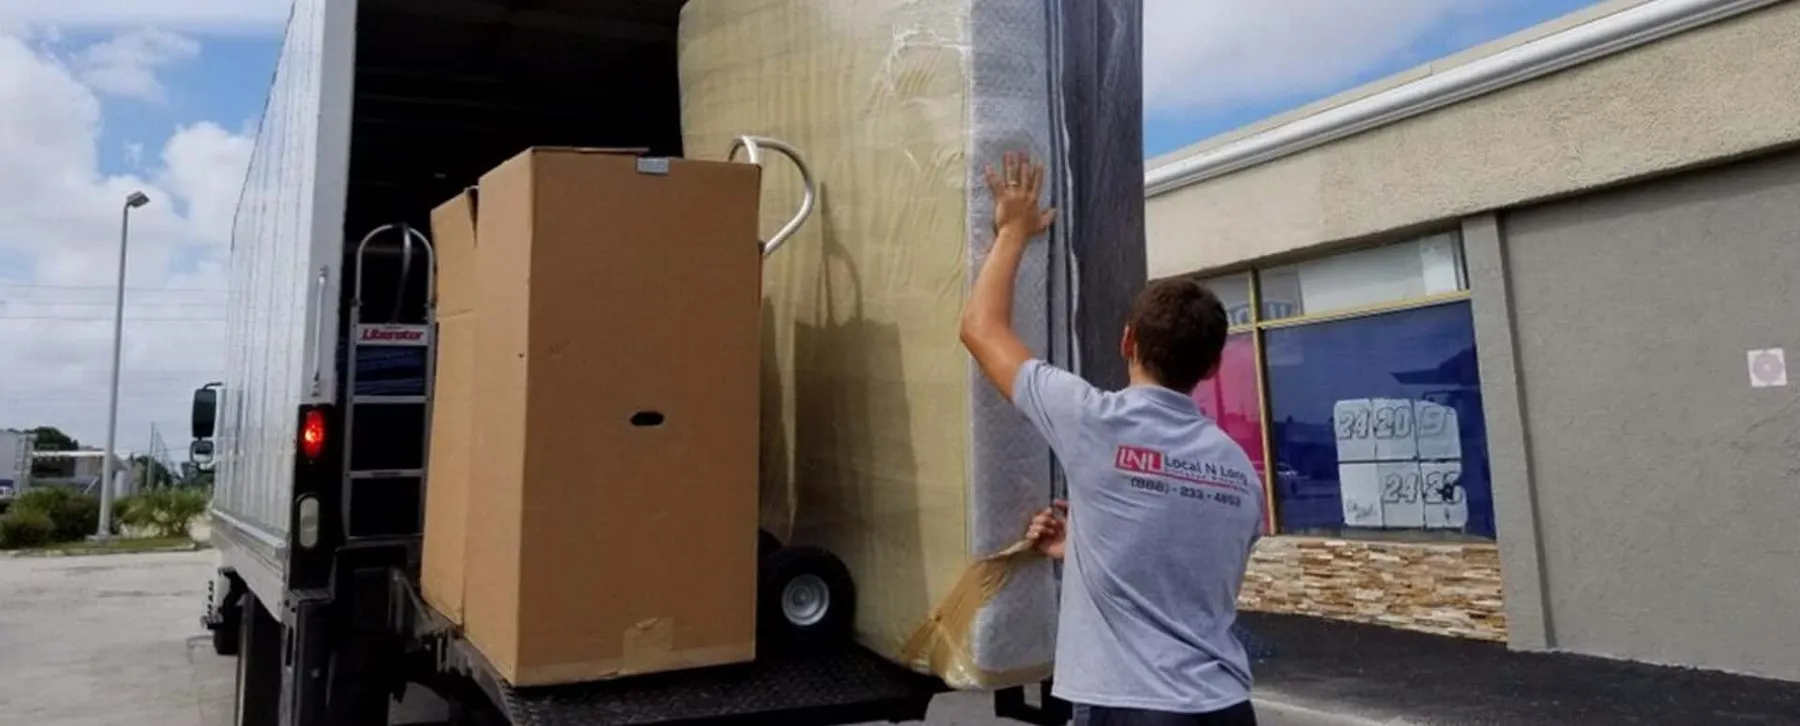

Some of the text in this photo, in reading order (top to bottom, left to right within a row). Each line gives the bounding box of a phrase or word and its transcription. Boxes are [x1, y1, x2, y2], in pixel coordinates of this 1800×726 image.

[1375, 406, 1412, 438] 20
[1117, 447, 1163, 472] LNL
[1164, 455, 1202, 474] Local
[1205, 460, 1217, 475] N
[1220, 464, 1248, 486] Long
[1384, 472, 1420, 504] 24
